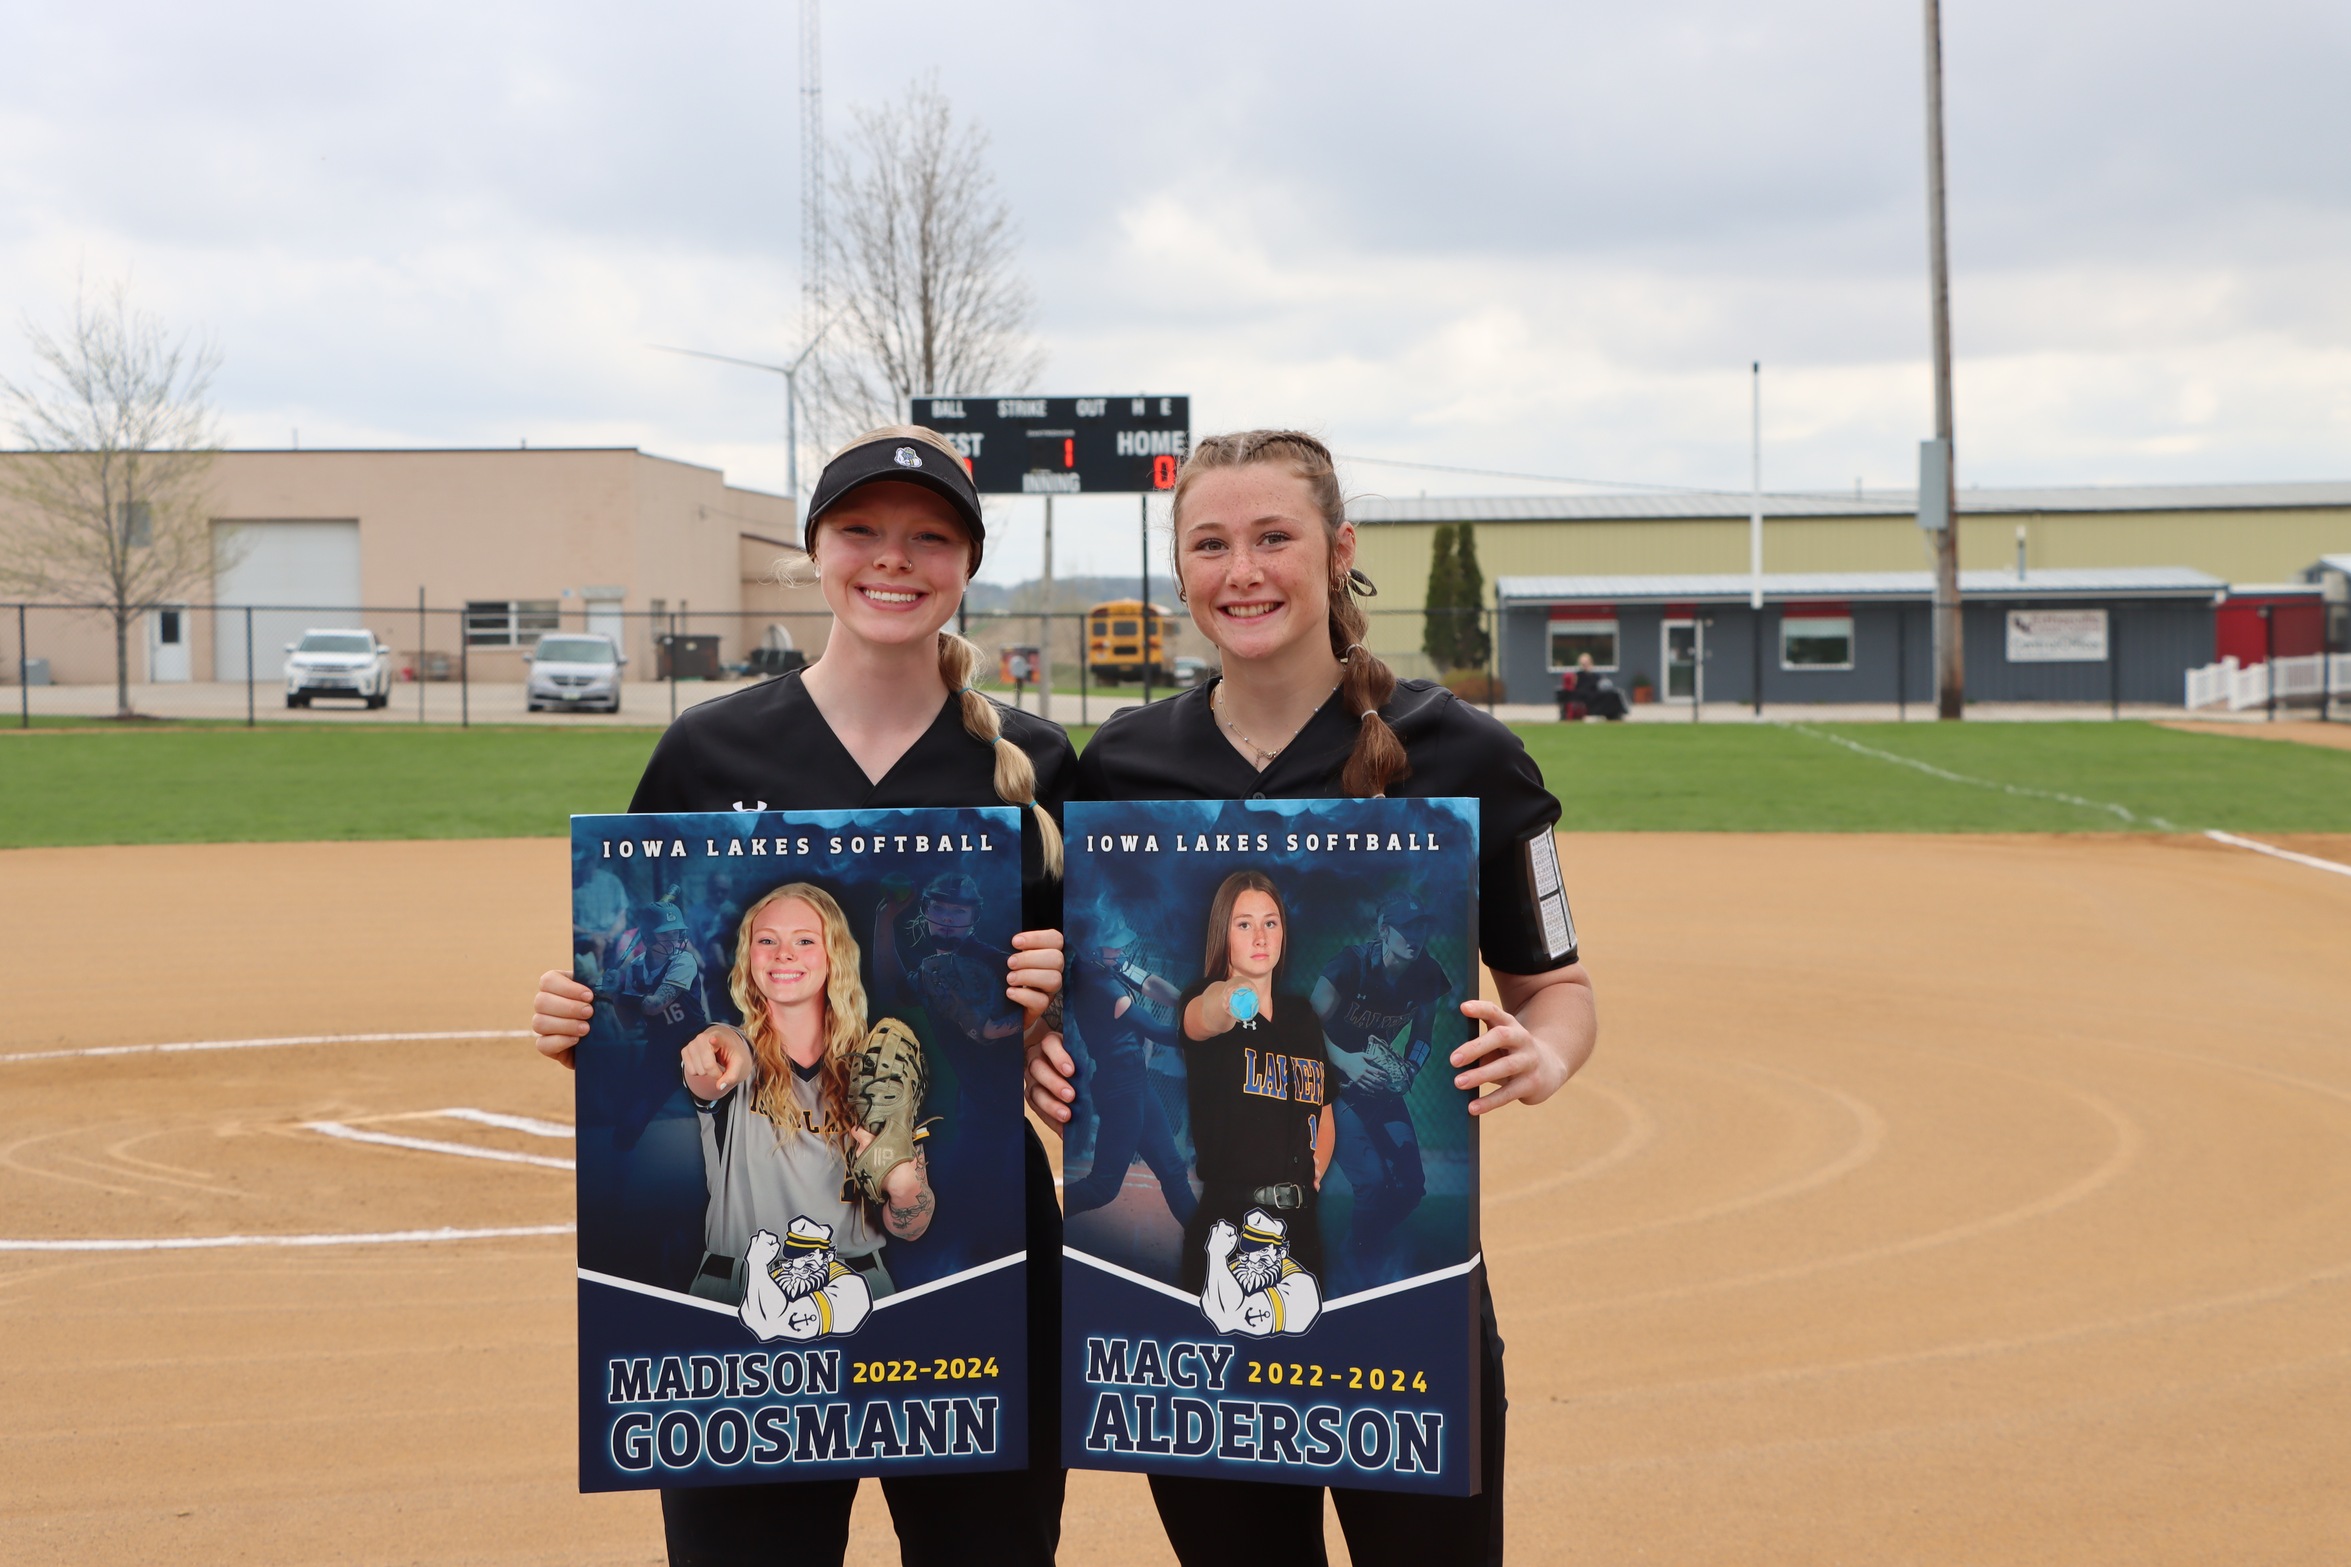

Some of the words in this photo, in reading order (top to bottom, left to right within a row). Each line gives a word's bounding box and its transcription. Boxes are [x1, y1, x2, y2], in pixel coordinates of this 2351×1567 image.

[931, 400, 967, 418] BALL
[997, 399, 1048, 418] STRIKE
[1076, 399, 1107, 417] OUT
[1131, 399, 1146, 416] H
[1159, 399, 1172, 416] E
[1064, 438, 1074, 468] 1
[1116, 431, 1186, 456] HOME
[1021, 472, 1081, 493] INNING
[1153, 455, 1176, 489] 0
[603, 839, 687, 858] IOWA
[707, 837, 810, 857] LAKES
[830, 834, 994, 855] SOFTBALL
[1087, 835, 1160, 853] IOWA
[1176, 834, 1269, 852] LAKES
[1287, 833, 1441, 852] SOFTBALL
[663, 1003, 685, 1025] 16
[608, 1350, 841, 1403] MADISON
[852, 1357, 1000, 1384] 2022-2024
[1086, 1337, 1235, 1390] MACY
[1248, 1361, 1428, 1393] 2022-2024
[610, 1397, 1000, 1472] GOOSMANN
[1086, 1392, 1445, 1475] ALDERSON
